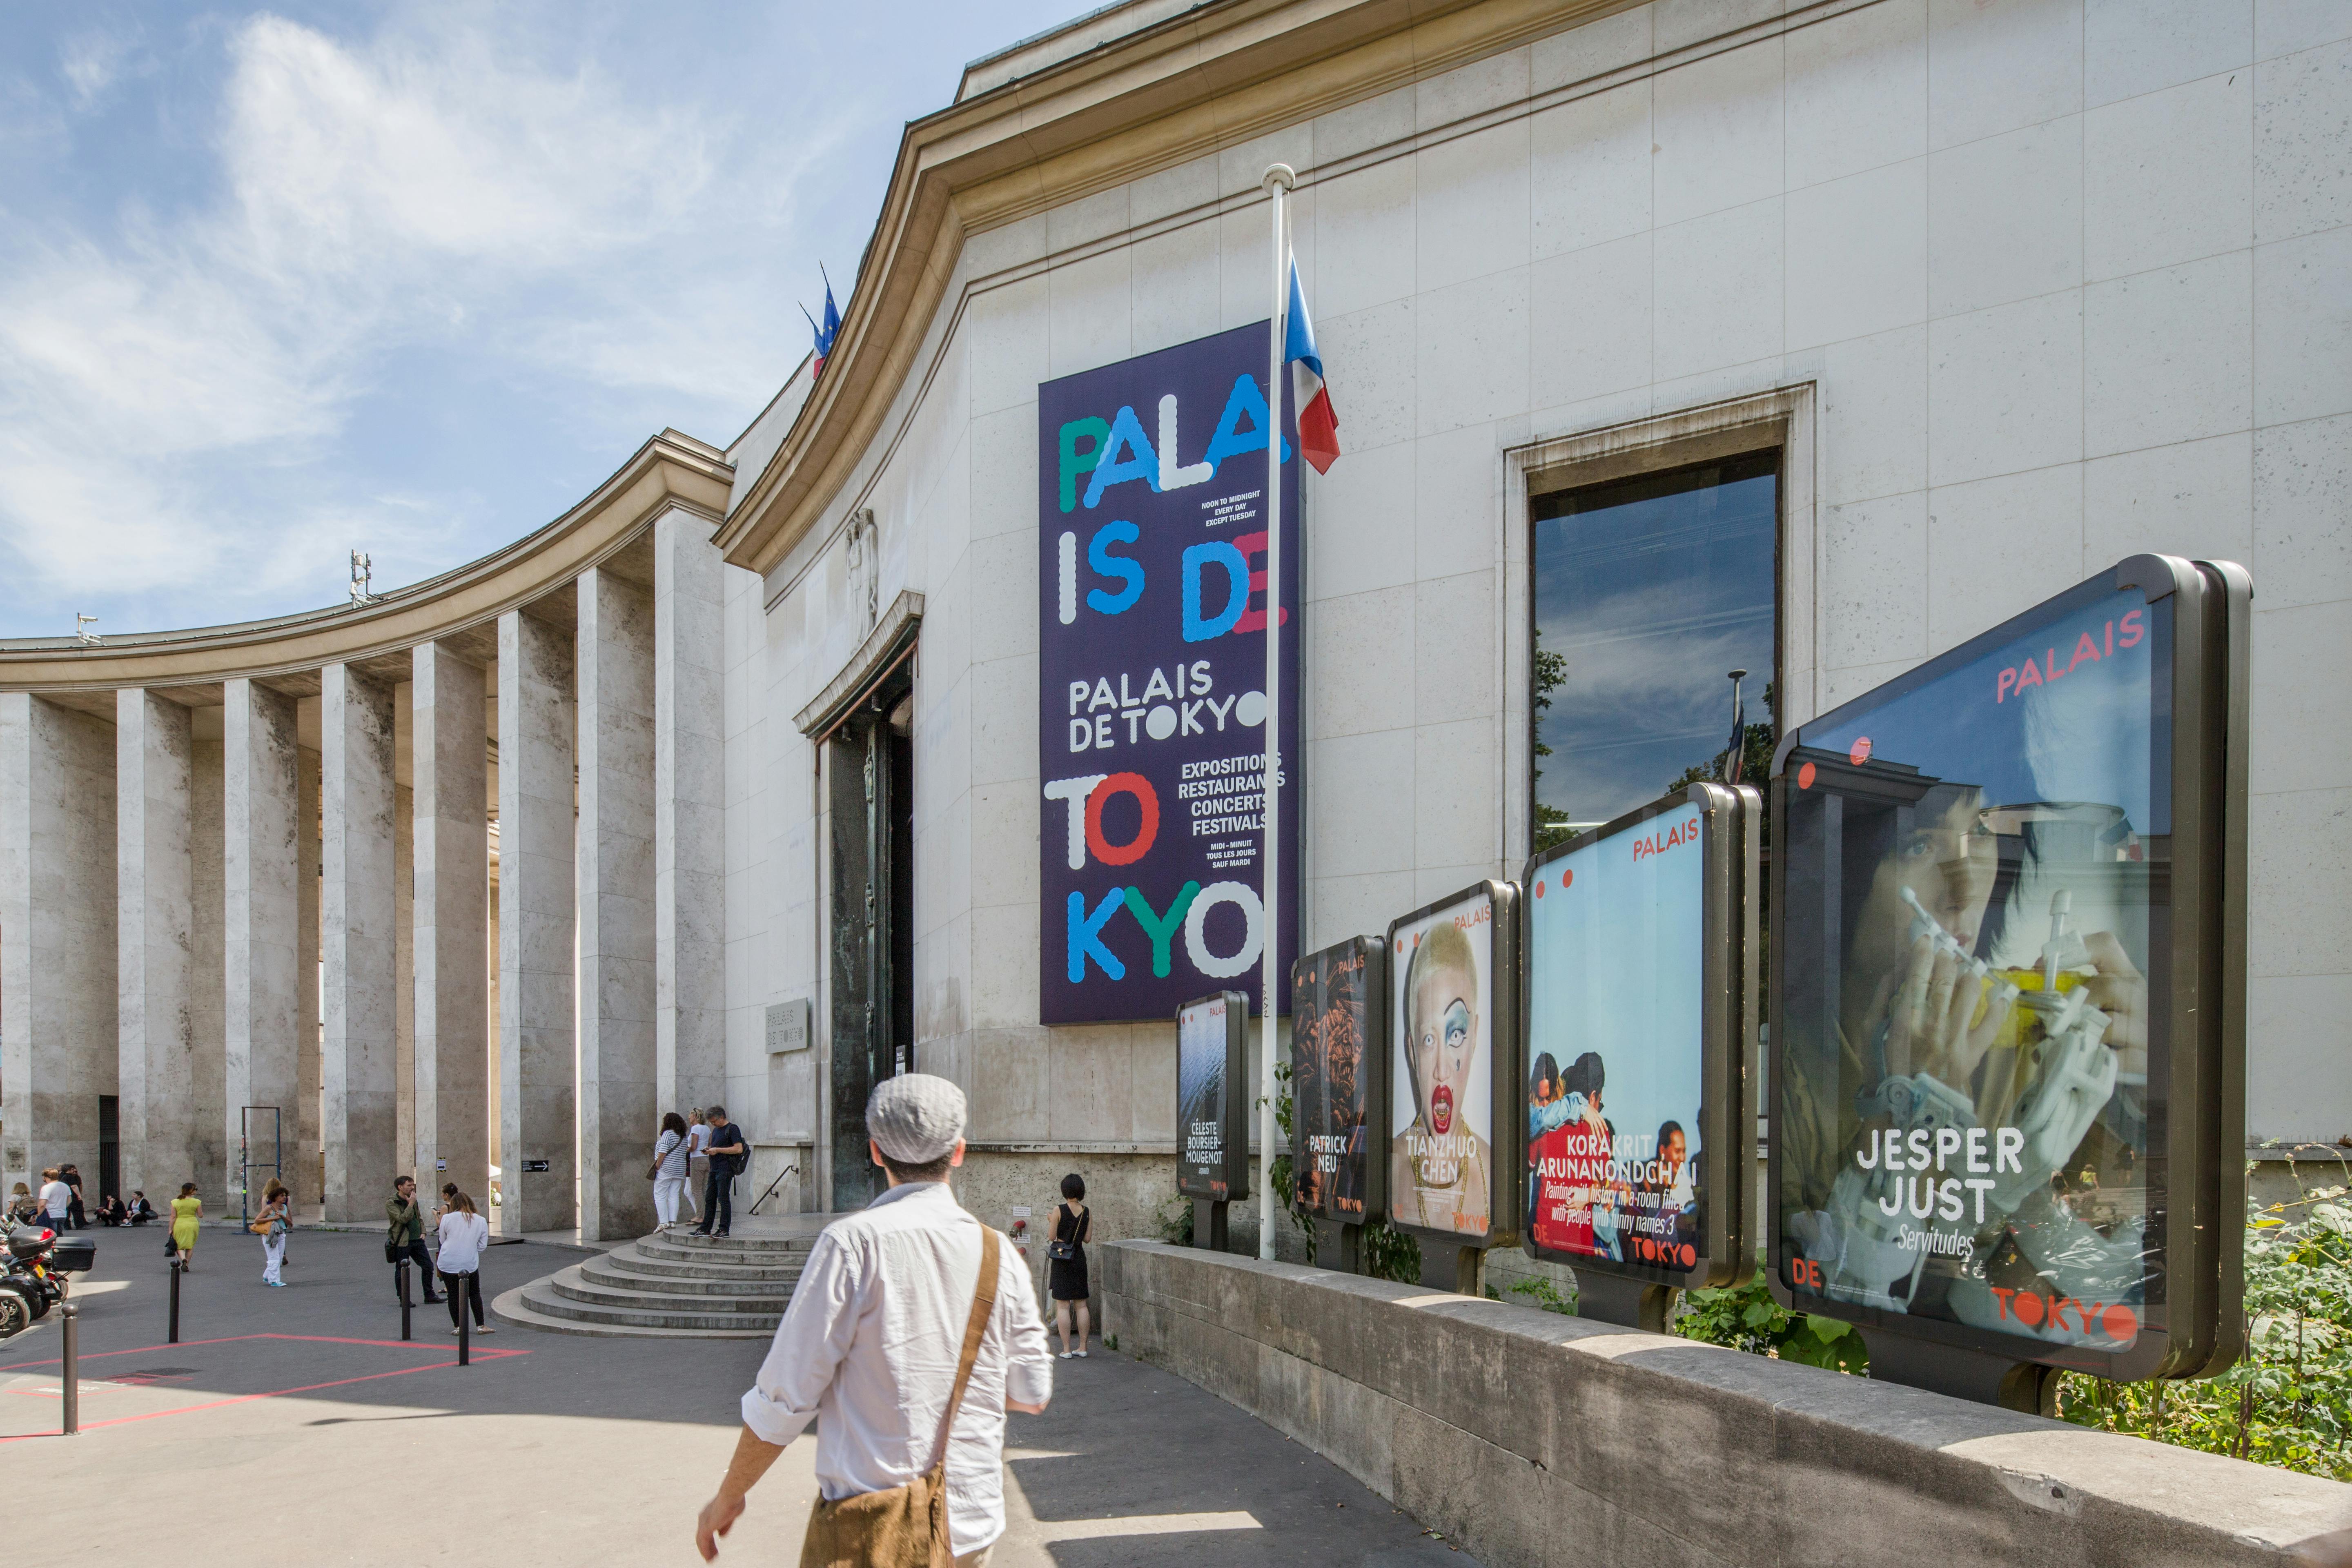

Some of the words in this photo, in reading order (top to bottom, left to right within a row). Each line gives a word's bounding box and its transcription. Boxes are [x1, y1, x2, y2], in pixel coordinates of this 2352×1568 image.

[1059, 374, 1292, 512] PALA
[1202, 499, 1219, 510] NOON
[1229, 490, 1260, 503] MIDNIGHT
[1215, 506, 1234, 515] EVERY
[1235, 503, 1247, 511] DAY
[1206, 516, 1229, 527] EXCEPT
[1229, 510, 1256, 521] TUESDAY
[1059, 520, 1145, 624] IS
[1183, 530, 1287, 642] DE
[1998, 610, 2144, 704] PALAIS
[1070, 660, 1212, 715] PALAIS
[1070, 714, 1114, 753] DE
[1121, 691, 1267, 744] TOKYO
[1179, 771, 1285, 799] RESTAURANS
[1044, 772, 1160, 870] TO
[1230, 840, 1252, 848] MINUIT
[1634, 818, 1698, 862] PALAIS
[1236, 849, 1256, 857] JOURS
[1454, 904, 1491, 933] PALAIS
[1067, 880, 1264, 983] KYO
[1339, 954, 1364, 974] PALAIS
[768, 1009, 793, 1027] PALAIS
[1209, 1004, 1226, 1017] PALAIS
[768, 1031, 776, 1045] DE
[779, 1027, 804, 1043] TOKYO
[1192, 1118, 1217, 1135] CÉLESTE
[1188, 1136, 1221, 1149] BOURSIER-
[1310, 1135, 1346, 1154] PATRICK
[1406, 1136, 1477, 1158] TIANZHUO
[1567, 1135, 1652, 1157] KORAKRIT
[1857, 1127, 2024, 1174] JESPER
[1186, 1150, 1223, 1164] MOUGENOT
[1318, 1154, 1336, 1173] NEU
[1421, 1159, 1458, 1182] CHEN
[1536, 1158, 1696, 1186] ARUNANONDCHAI
[1297, 1190, 1305, 1203] DE
[1337, 1196, 1362, 1213] TOKYO
[1545, 1180, 1572, 1205] Painting
[1574, 1183, 1589, 1202] with
[1590, 1184, 1617, 1209] history
[1618, 1186, 1627, 1205] in
[1629, 1191, 1635, 1206] a
[1637, 1192, 1660, 1208] room
[1879, 1176, 1996, 1224] JUST
[1452, 1212, 1488, 1232] TOKYO
[1552, 1203, 1566, 1221] with
[1566, 1206, 1591, 1228] people
[1593, 1208, 1609, 1227] with
[1611, 1209, 1635, 1234] funny
[1636, 1214, 1665, 1234] names
[1667, 1214, 1675, 1235] 3
[1533, 1223, 1550, 1243] DE
[1632, 1237, 1696, 1266] TOKYO
[1898, 1223, 1975, 1257] Servitudes
[1793, 1258, 1822, 1288] DE
[1991, 1287, 2138, 1342] TOKYO
